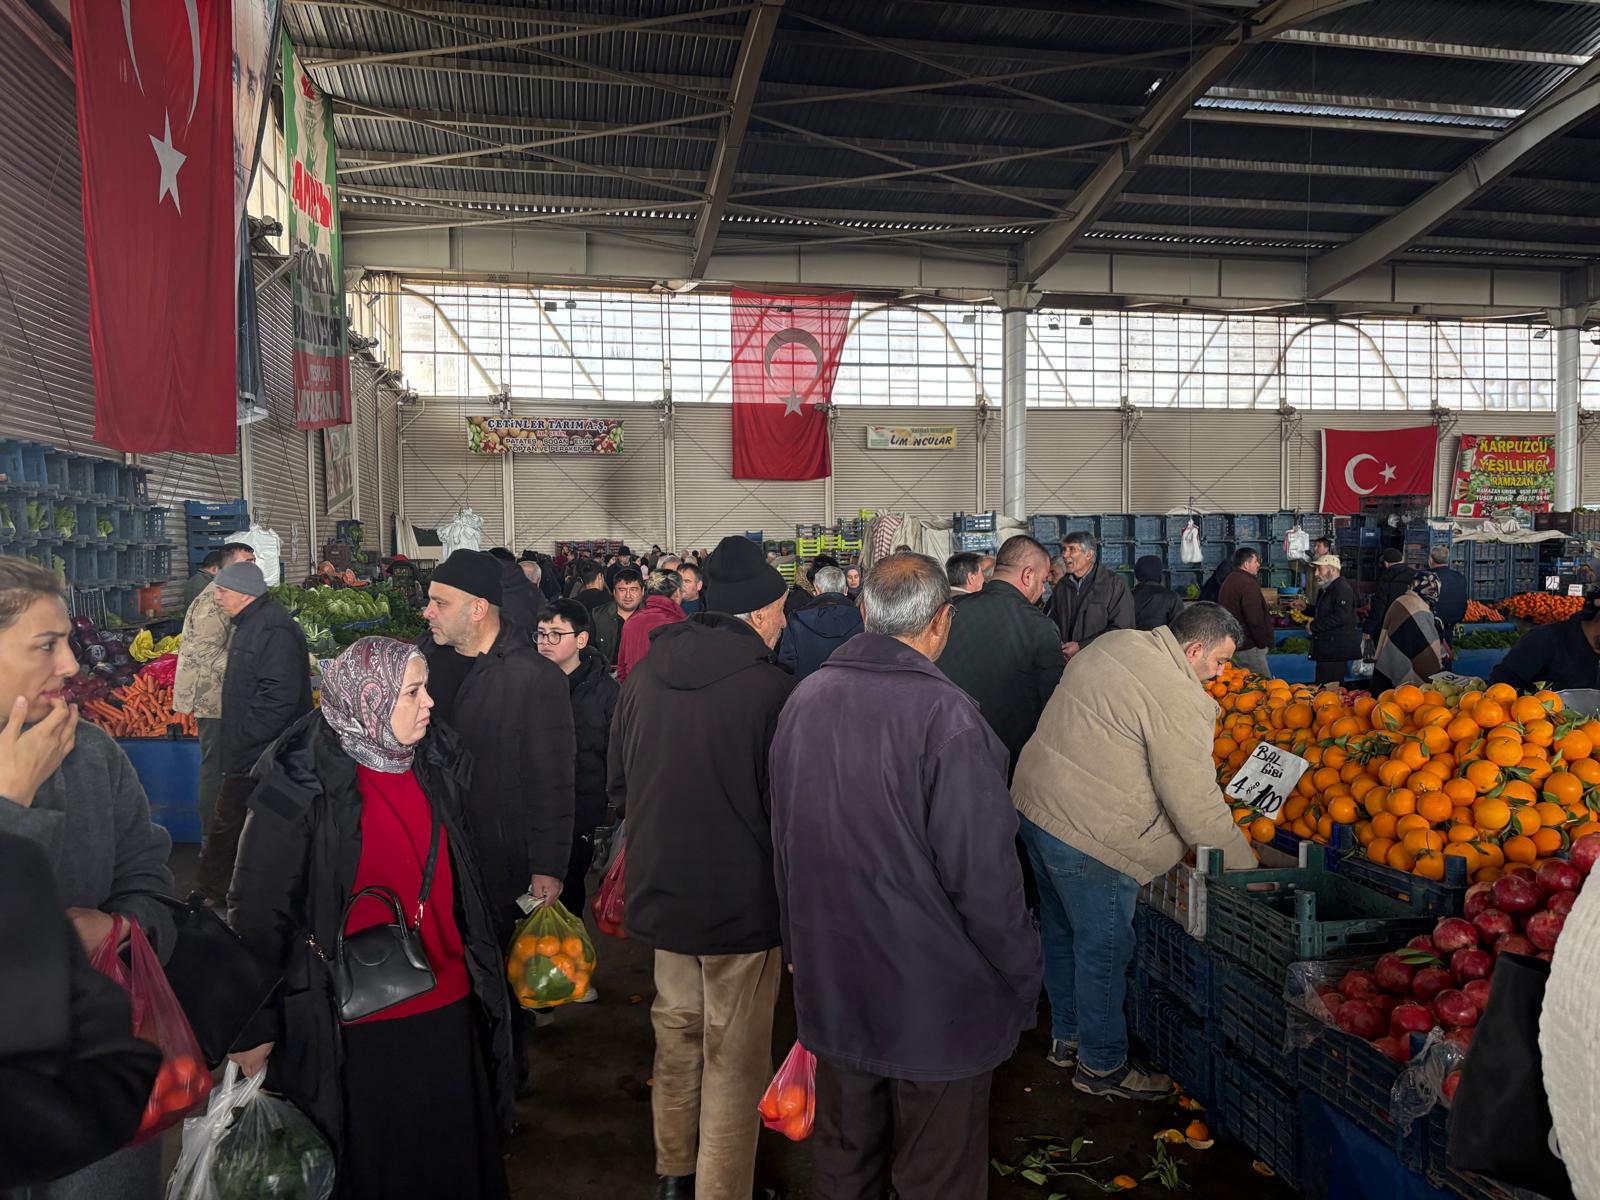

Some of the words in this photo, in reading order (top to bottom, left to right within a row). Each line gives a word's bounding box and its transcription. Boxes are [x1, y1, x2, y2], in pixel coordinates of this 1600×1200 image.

[548, 419, 584, 430] TARIM
[587, 420, 608, 433] A.Ş.
[543, 437, 569, 445] SOĞAN
[1479, 438, 1548, 453] KARPUZCU
[1491, 476, 1534, 486] RAMAZAN
[1252, 745, 1281, 767] BAL
[1231, 775, 1249, 794] 4
[1248, 783, 1283, 813] 100
